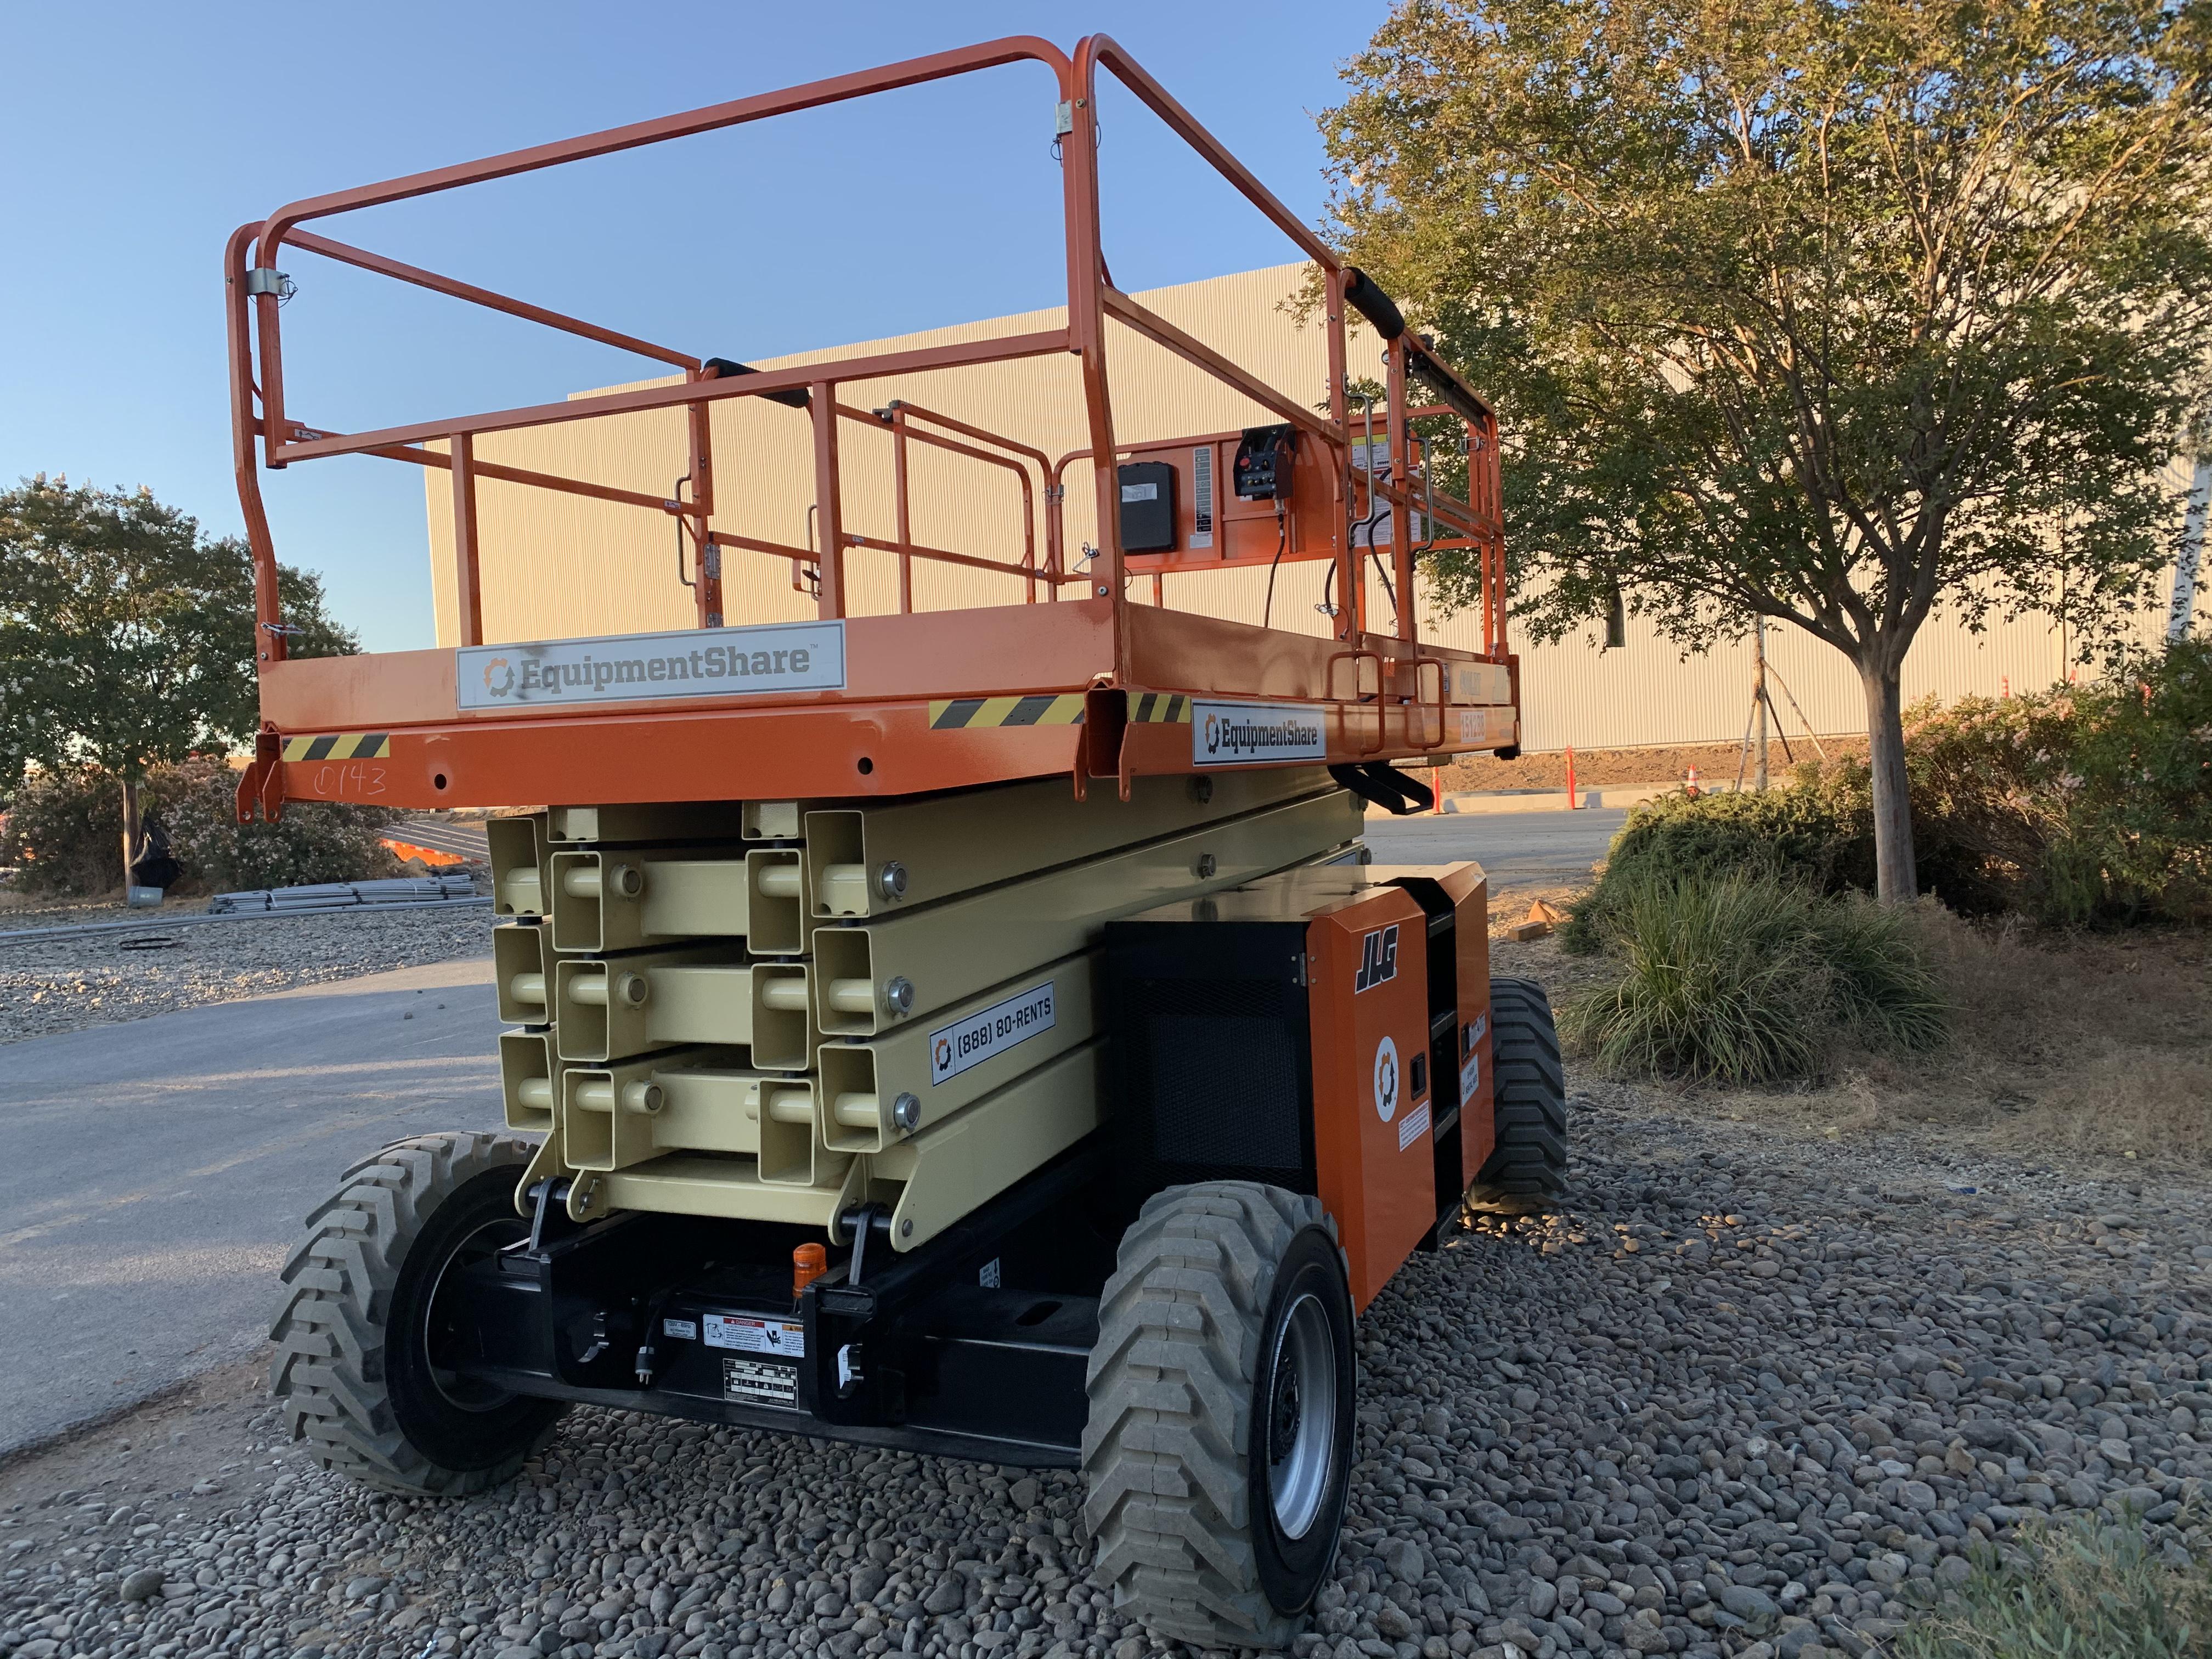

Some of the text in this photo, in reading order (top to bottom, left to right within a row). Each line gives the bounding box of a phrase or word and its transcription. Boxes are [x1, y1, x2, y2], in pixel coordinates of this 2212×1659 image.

[521, 646, 810, 694] EquipmentShare
[1221, 718, 1317, 754] EquipmentShare
[1355, 924, 1399, 995] JLG
[958, 997, 1051, 1058] (888) 80-RENTS
